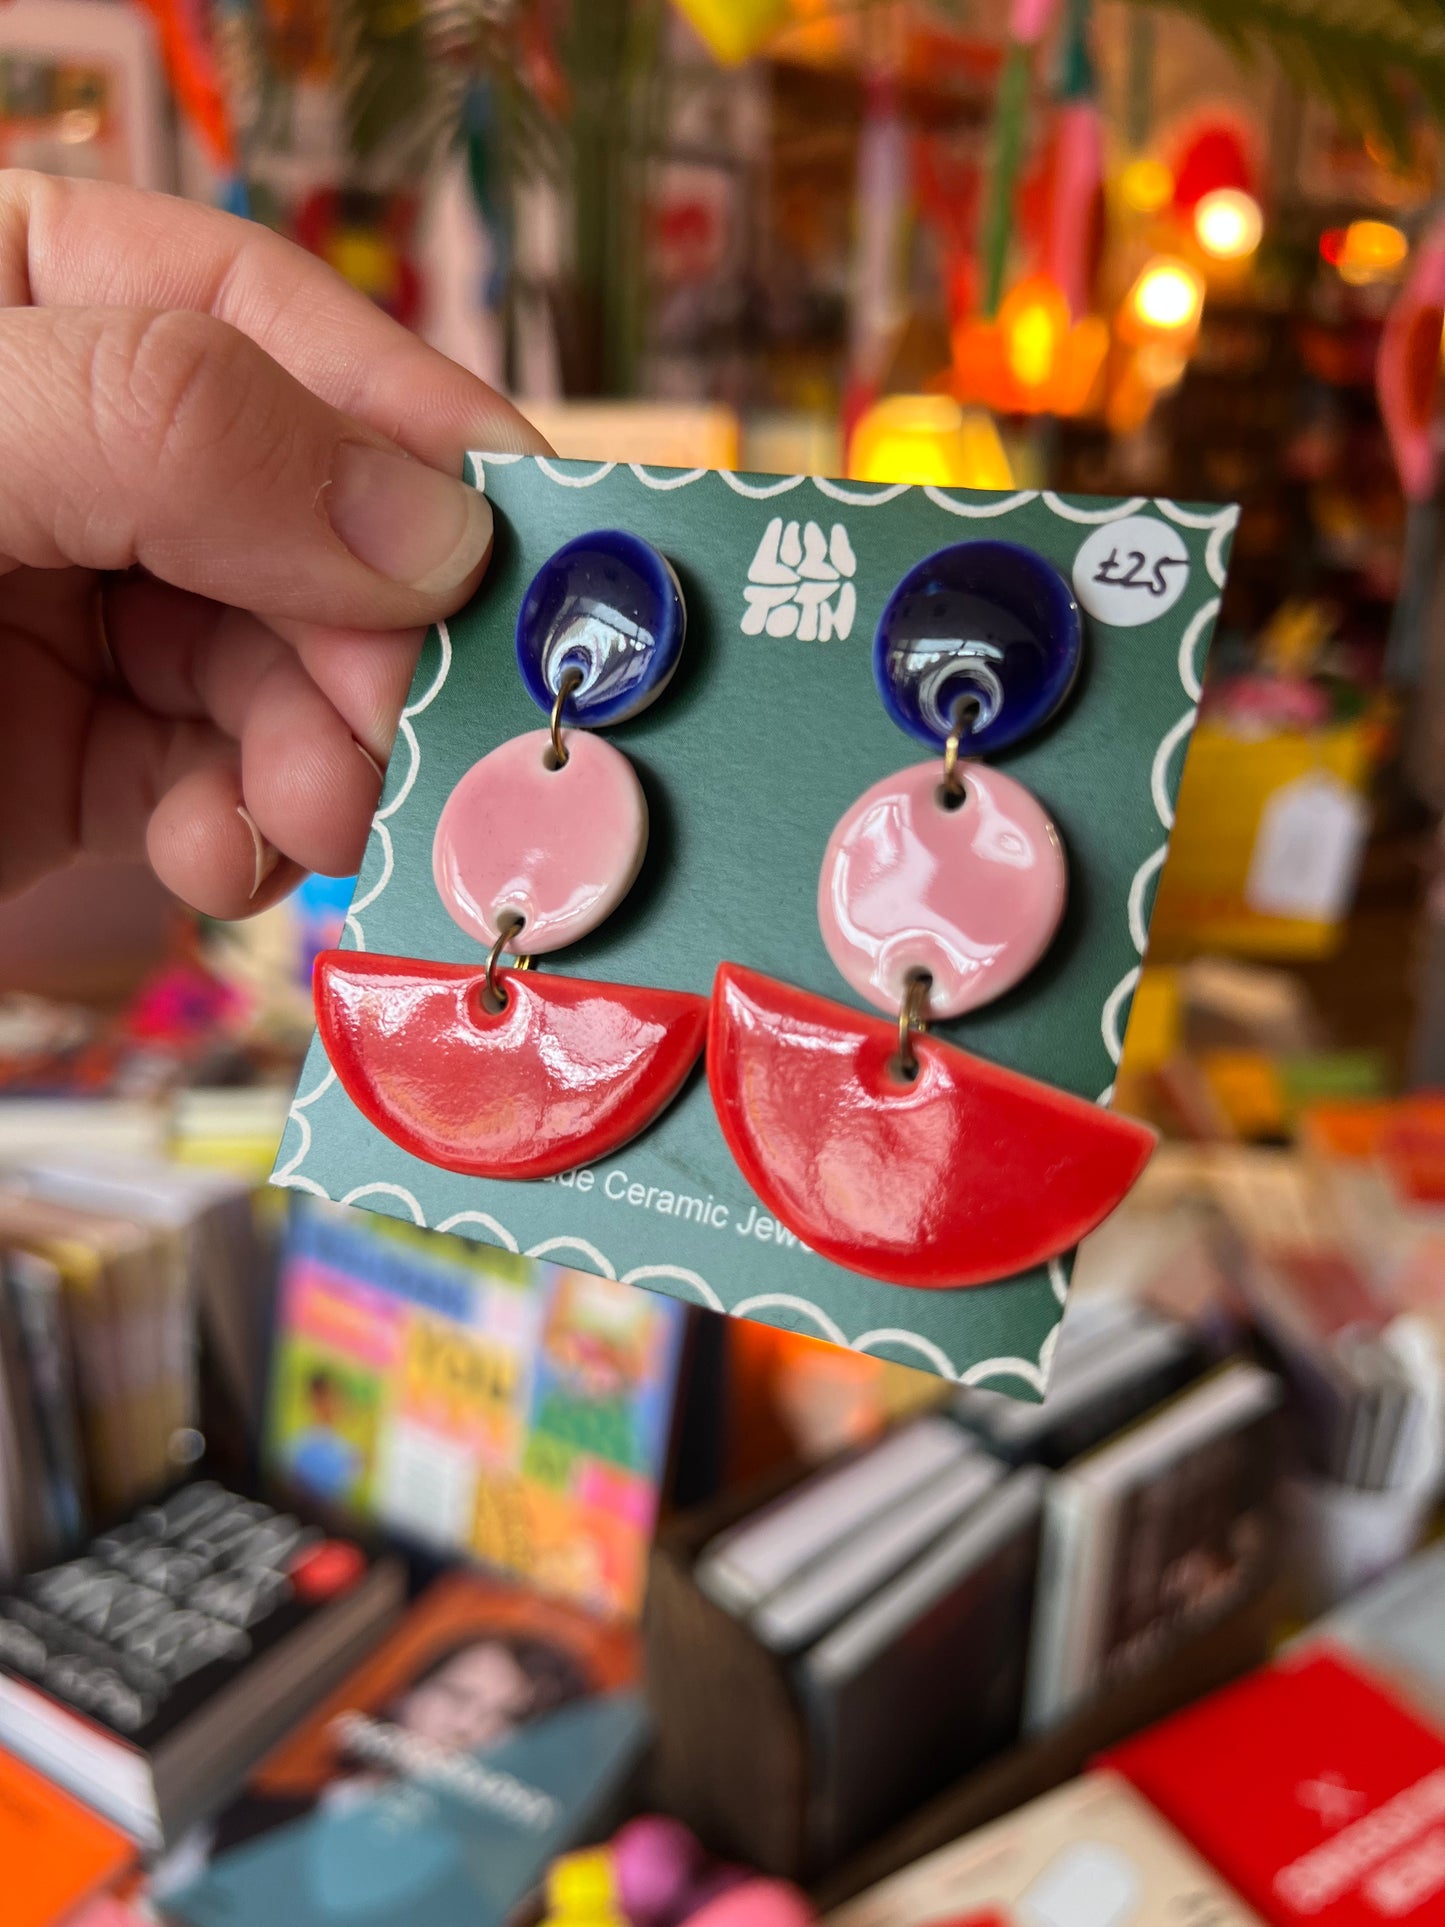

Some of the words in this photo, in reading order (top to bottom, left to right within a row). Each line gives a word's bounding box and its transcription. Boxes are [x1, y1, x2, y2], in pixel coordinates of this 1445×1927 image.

[1093, 547, 1190, 597] £25
[605, 1169, 729, 1228] Ceramic
[736, 1206, 814, 1252] Jew
